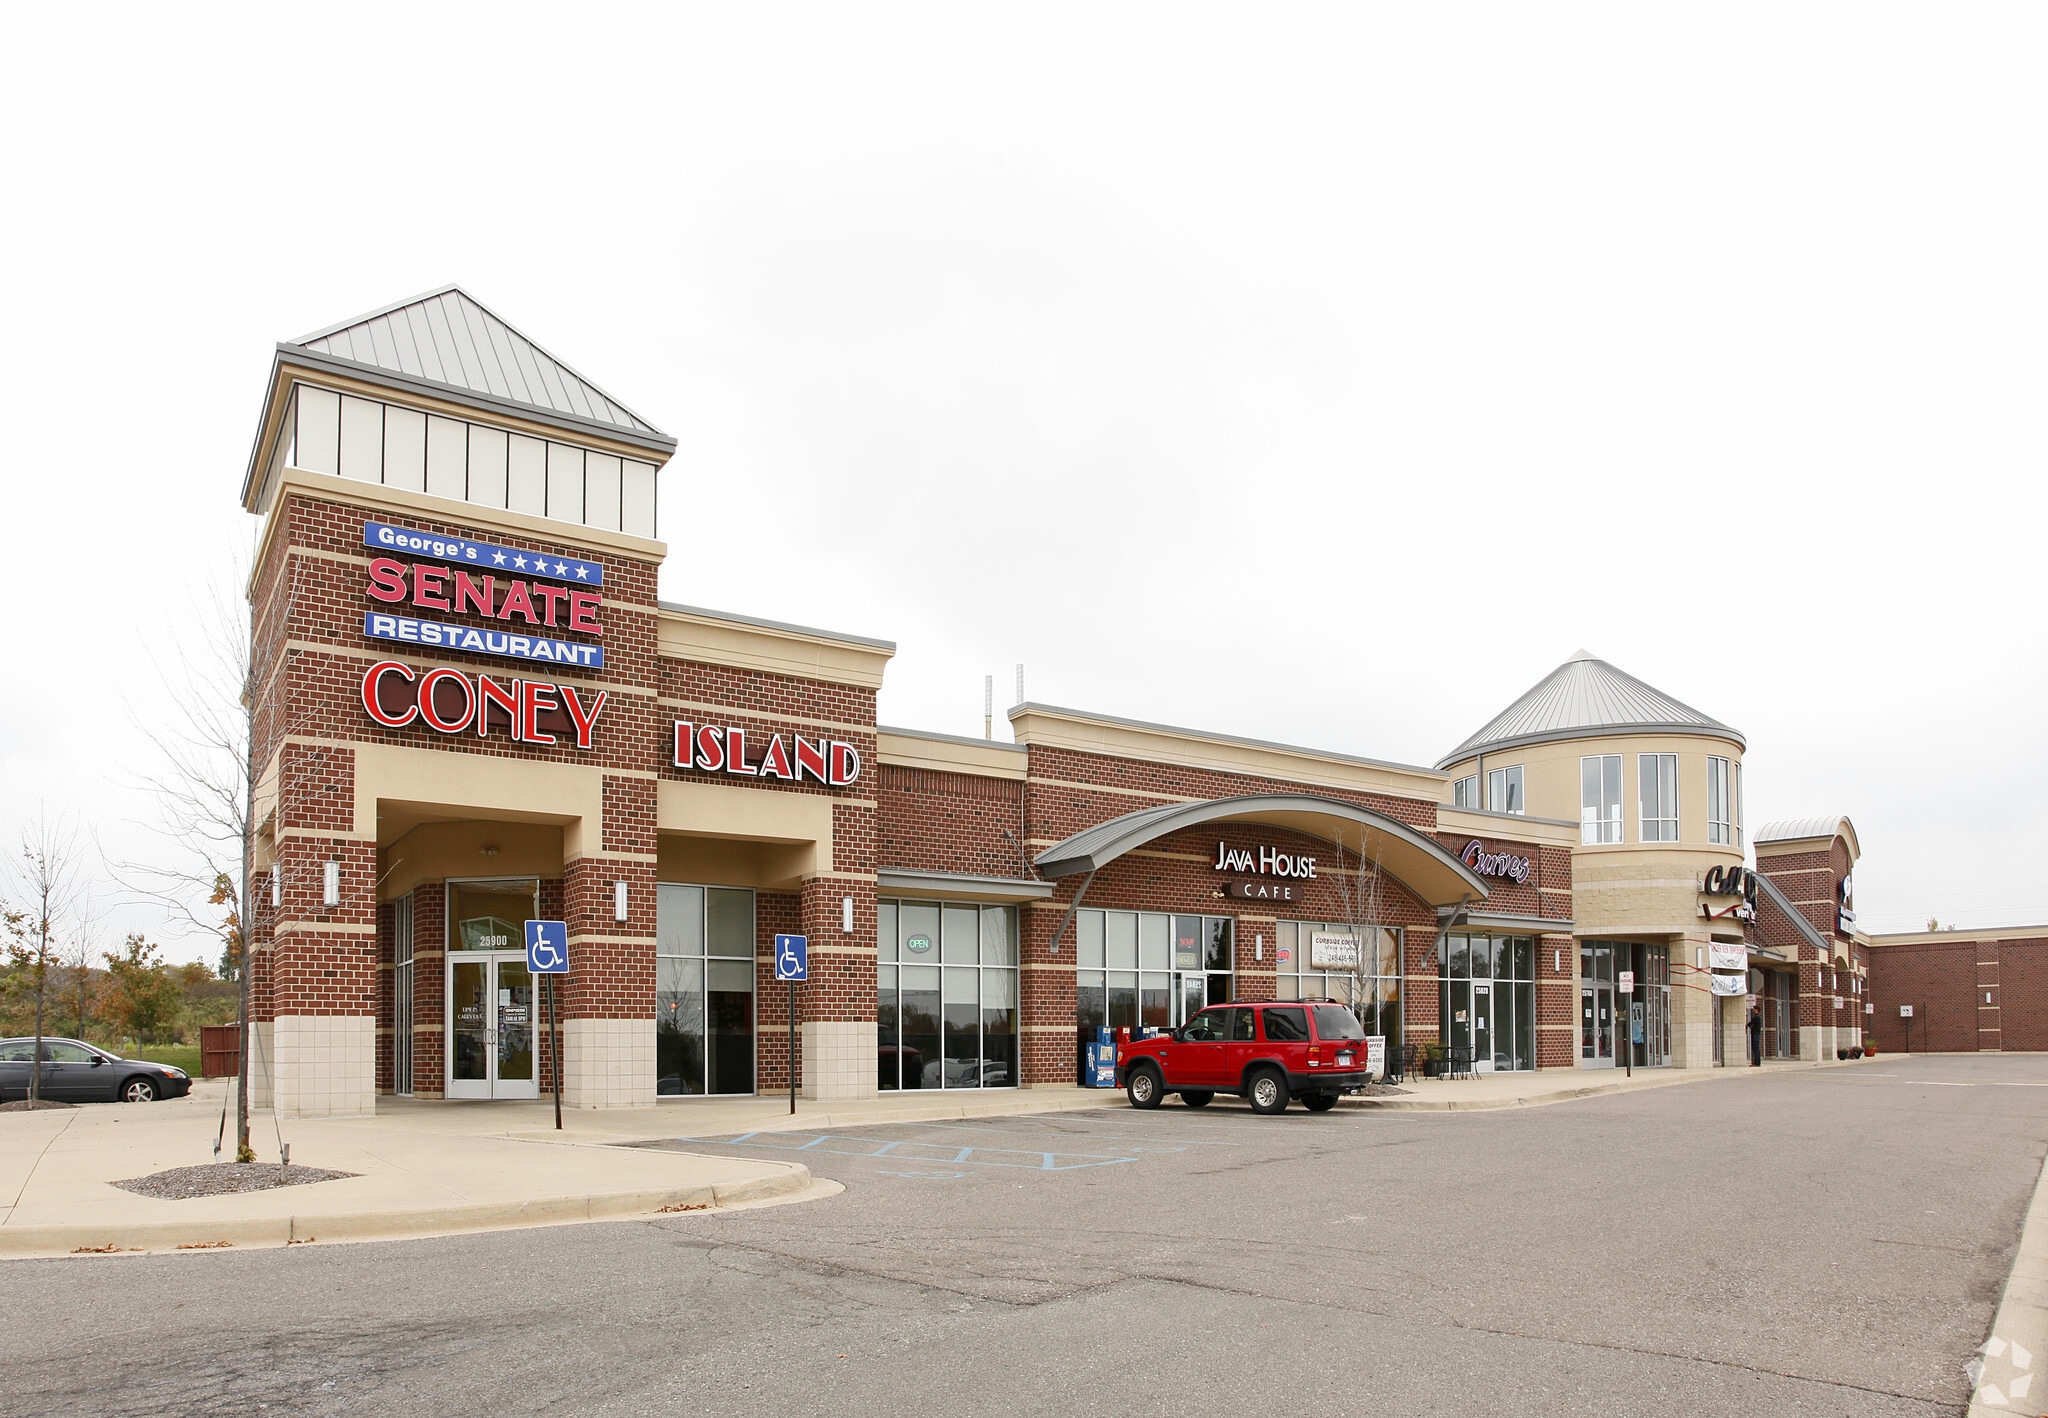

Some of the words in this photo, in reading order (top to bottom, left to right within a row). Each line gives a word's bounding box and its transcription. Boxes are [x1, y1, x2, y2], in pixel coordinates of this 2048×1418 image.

[378, 527, 478, 560] George's
[366, 557, 603, 636] SENATE
[373, 615, 597, 665] RESTAURANT
[361, 660, 608, 749] CONEY
[674, 719, 861, 786] ISLAND
[1215, 841, 1256, 873] JAVA
[1260, 845, 1318, 878] HOUSE
[1461, 839, 1530, 883] Curves
[1244, 884, 1291, 900] CAFE
[480, 935, 508, 947] 25900
[909, 939, 929, 949] OPEN
[1315, 937, 1340, 945] CURBSIDE
